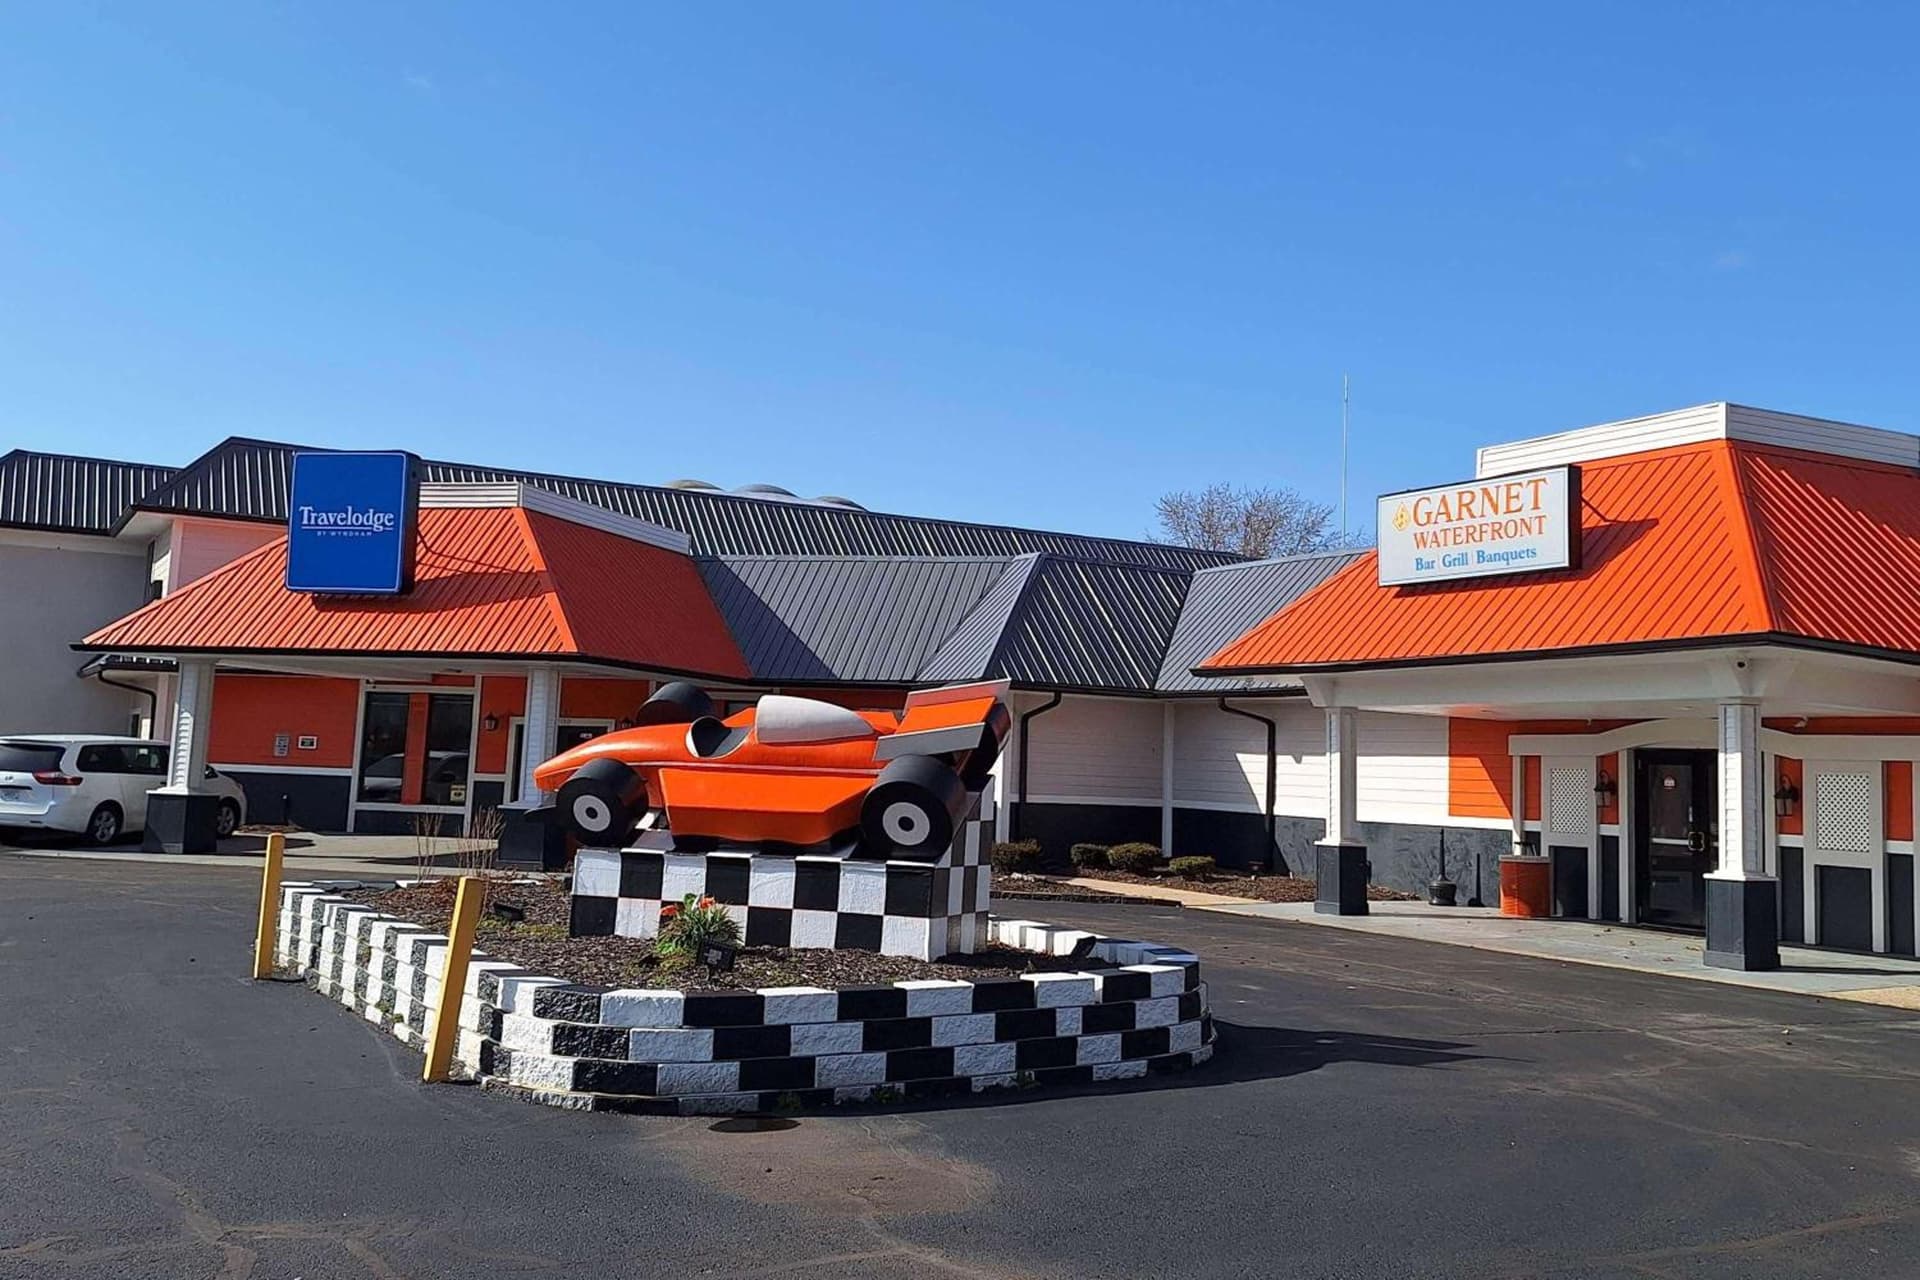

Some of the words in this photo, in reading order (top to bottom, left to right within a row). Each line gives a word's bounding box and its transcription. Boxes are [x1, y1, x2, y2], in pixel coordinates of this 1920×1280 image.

[1412, 477, 1549, 528] GARNET
[299, 505, 395, 532] Travelodge
[1413, 514, 1547, 550] WATERFRONT
[1415, 557, 1436, 571] Bar
[1442, 551, 1469, 568] Grill
[1476, 547, 1537, 566] Banquets
